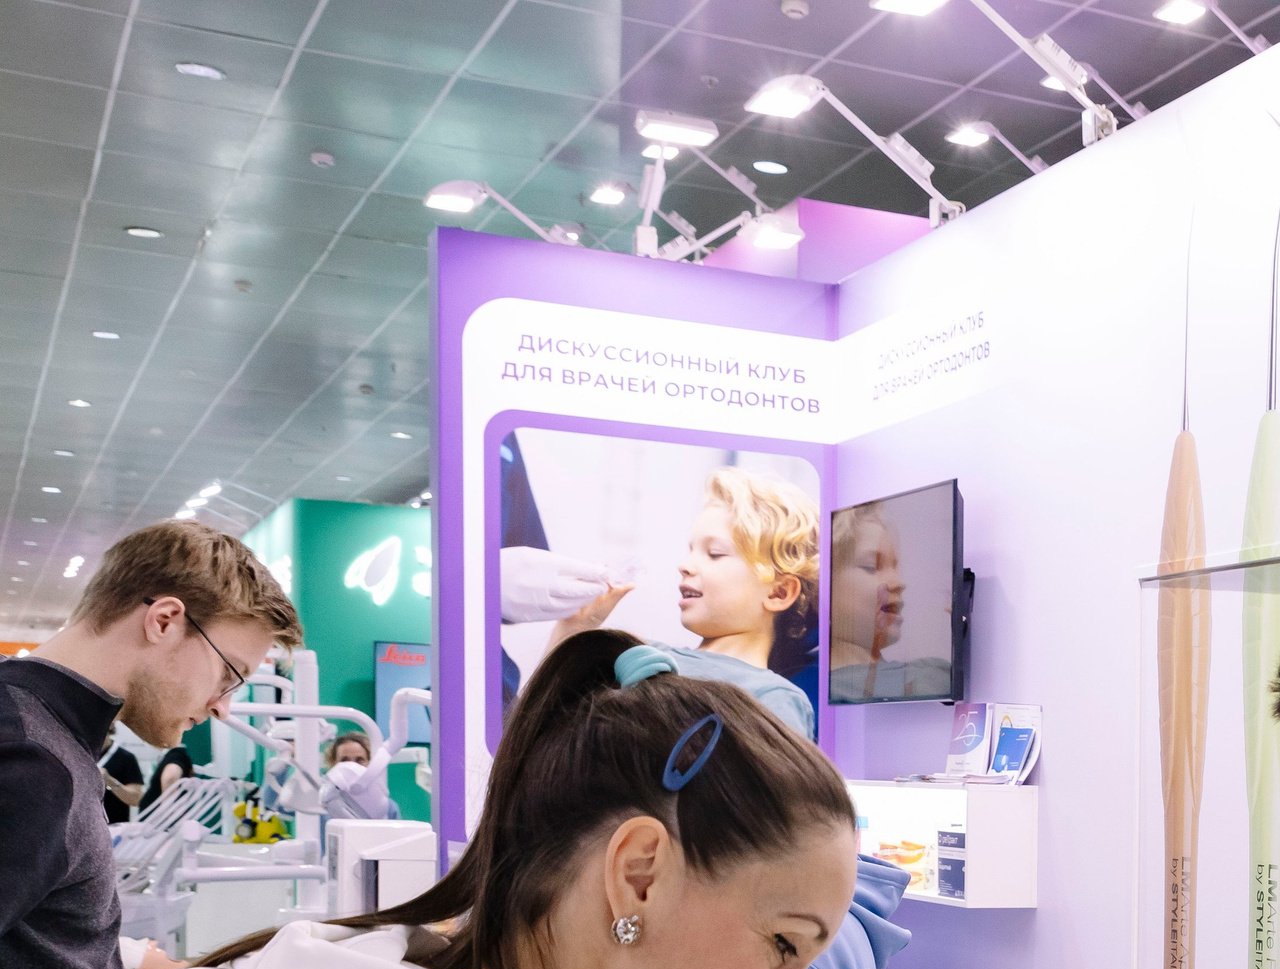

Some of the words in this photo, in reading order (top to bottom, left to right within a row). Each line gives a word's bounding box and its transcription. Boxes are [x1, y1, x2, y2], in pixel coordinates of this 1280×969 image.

[518, 334, 739, 376] ДИСКУССИОННЫЙ
[748, 363, 806, 384] КЛУБ
[926, 341, 991, 379] ОРТОДОНТОВ
[501, 362, 552, 382] ДЛЯ
[562, 368, 656, 394] ВРАЧЕЙ
[664, 382, 820, 414] ОРТОДОНТОВ
[1171, 858, 1179, 878] by
[1256, 864, 1265, 885] by
[1266, 864, 1278, 950] LMArte
